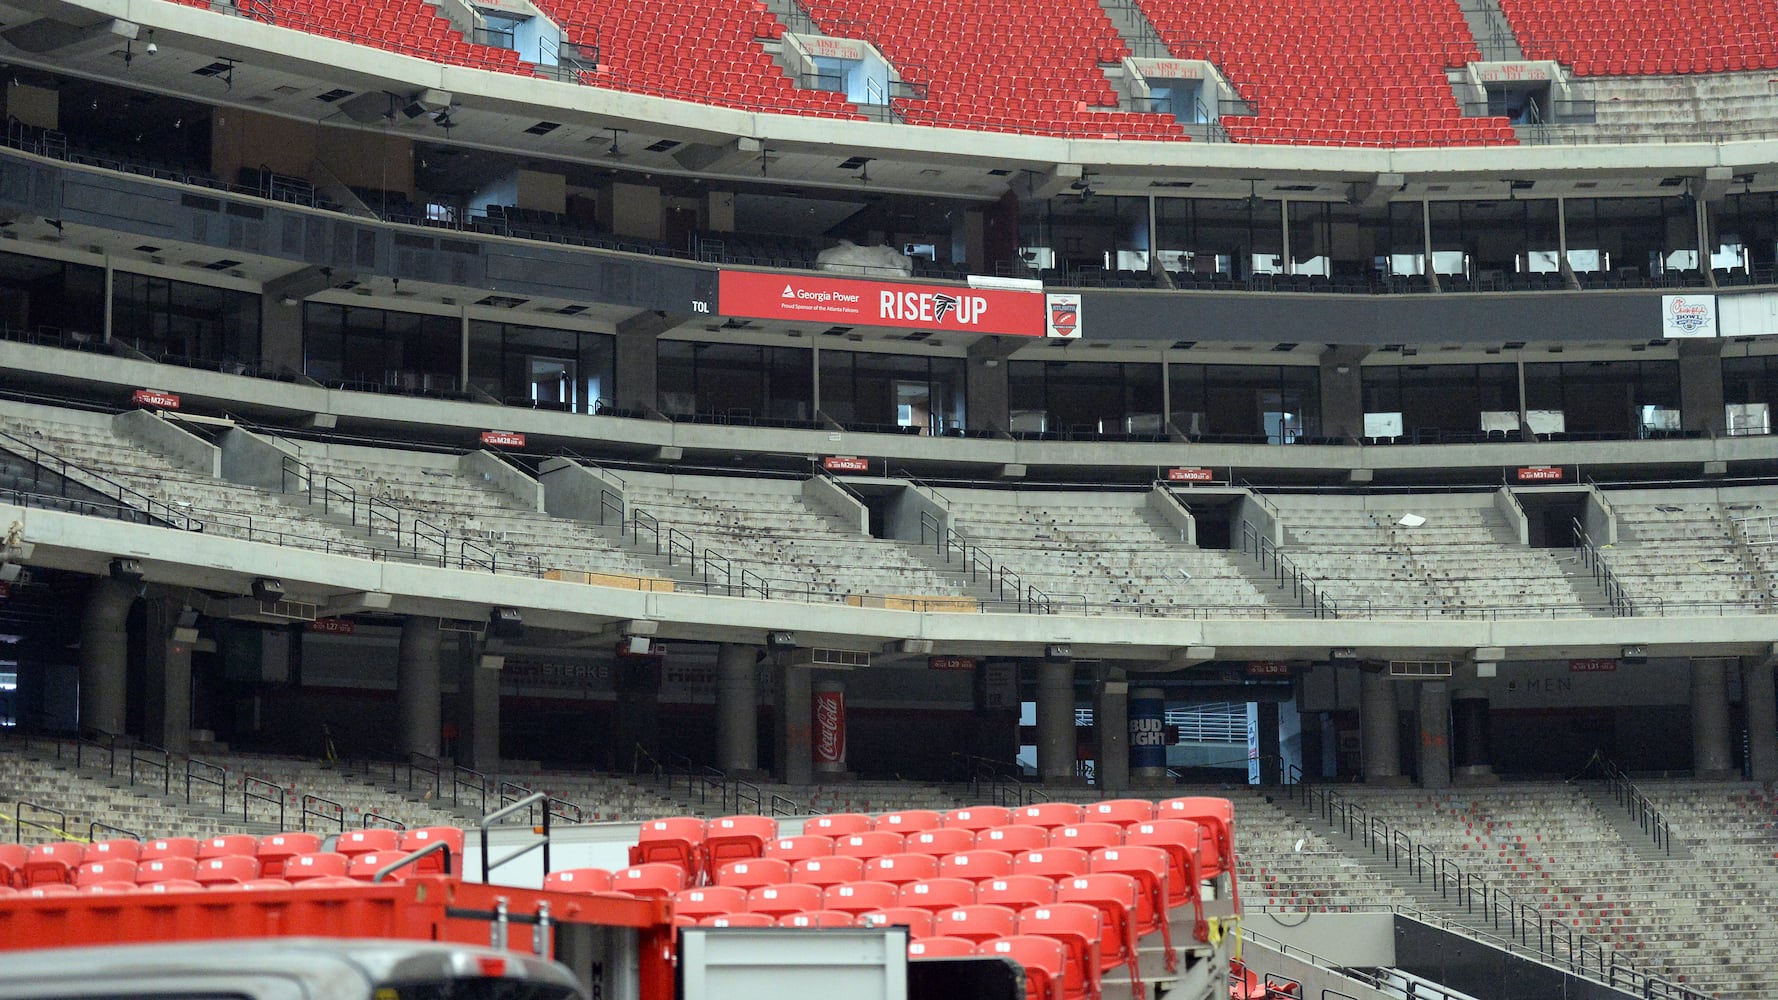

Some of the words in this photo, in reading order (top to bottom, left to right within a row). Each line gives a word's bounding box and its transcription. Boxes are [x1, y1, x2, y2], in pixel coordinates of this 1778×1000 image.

[797, 289, 831, 302] Georgia
[833, 292, 859, 302] Power
[692, 300, 710, 314] TOL
[880, 290, 933, 321] RISE
[956, 296, 987, 324] UP
[151, 396, 164, 404] M27
[497, 437, 511, 445] M28
[326, 623, 338, 631] L27
[948, 660, 960, 668] L29
[543, 663, 608, 680] STEAKS
[1527, 678, 1571, 691] MEN
[817, 695, 838, 761] Coca-Cola
[1129, 719, 1163, 732] BUD
[1129, 732, 1166, 745] IGHT
